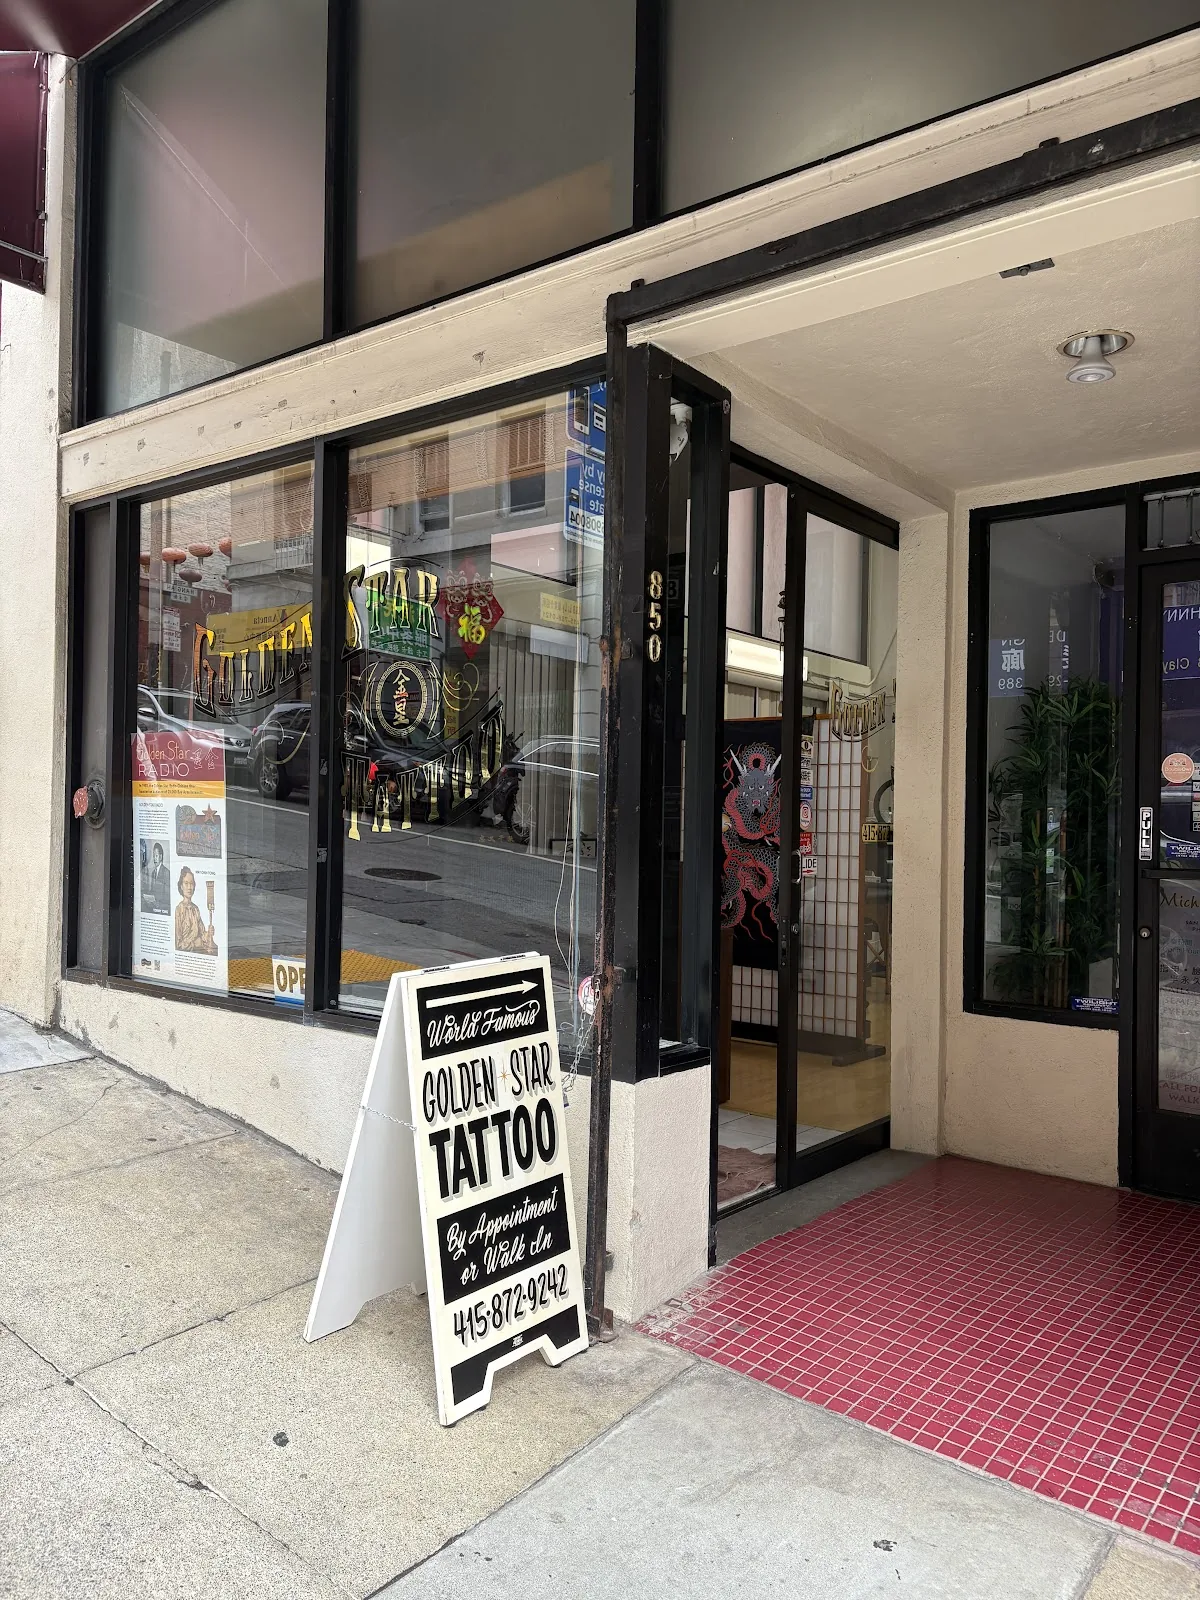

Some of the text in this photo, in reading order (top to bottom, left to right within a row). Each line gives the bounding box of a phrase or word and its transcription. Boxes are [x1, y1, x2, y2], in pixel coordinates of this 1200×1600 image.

[341, 564, 442, 662] STAR
[649, 570, 663, 663] 850
[831, 682, 887, 738] GOLDEN
[138, 763, 190, 777] RADIO
[167, 740, 190, 761] Star
[341, 700, 504, 841] TATTOO
[1141, 811, 1151, 848] PULL
[427, 1000, 540, 1048] World Famous
[1075, 998, 1118, 1006] TWILIGHT
[423, 1042, 555, 1124] GOLDEN STAR
[429, 1098, 558, 1201] TATTOO
[446, 1186, 558, 1261] By Appointment
[460, 1225, 553, 1285] or Walk In
